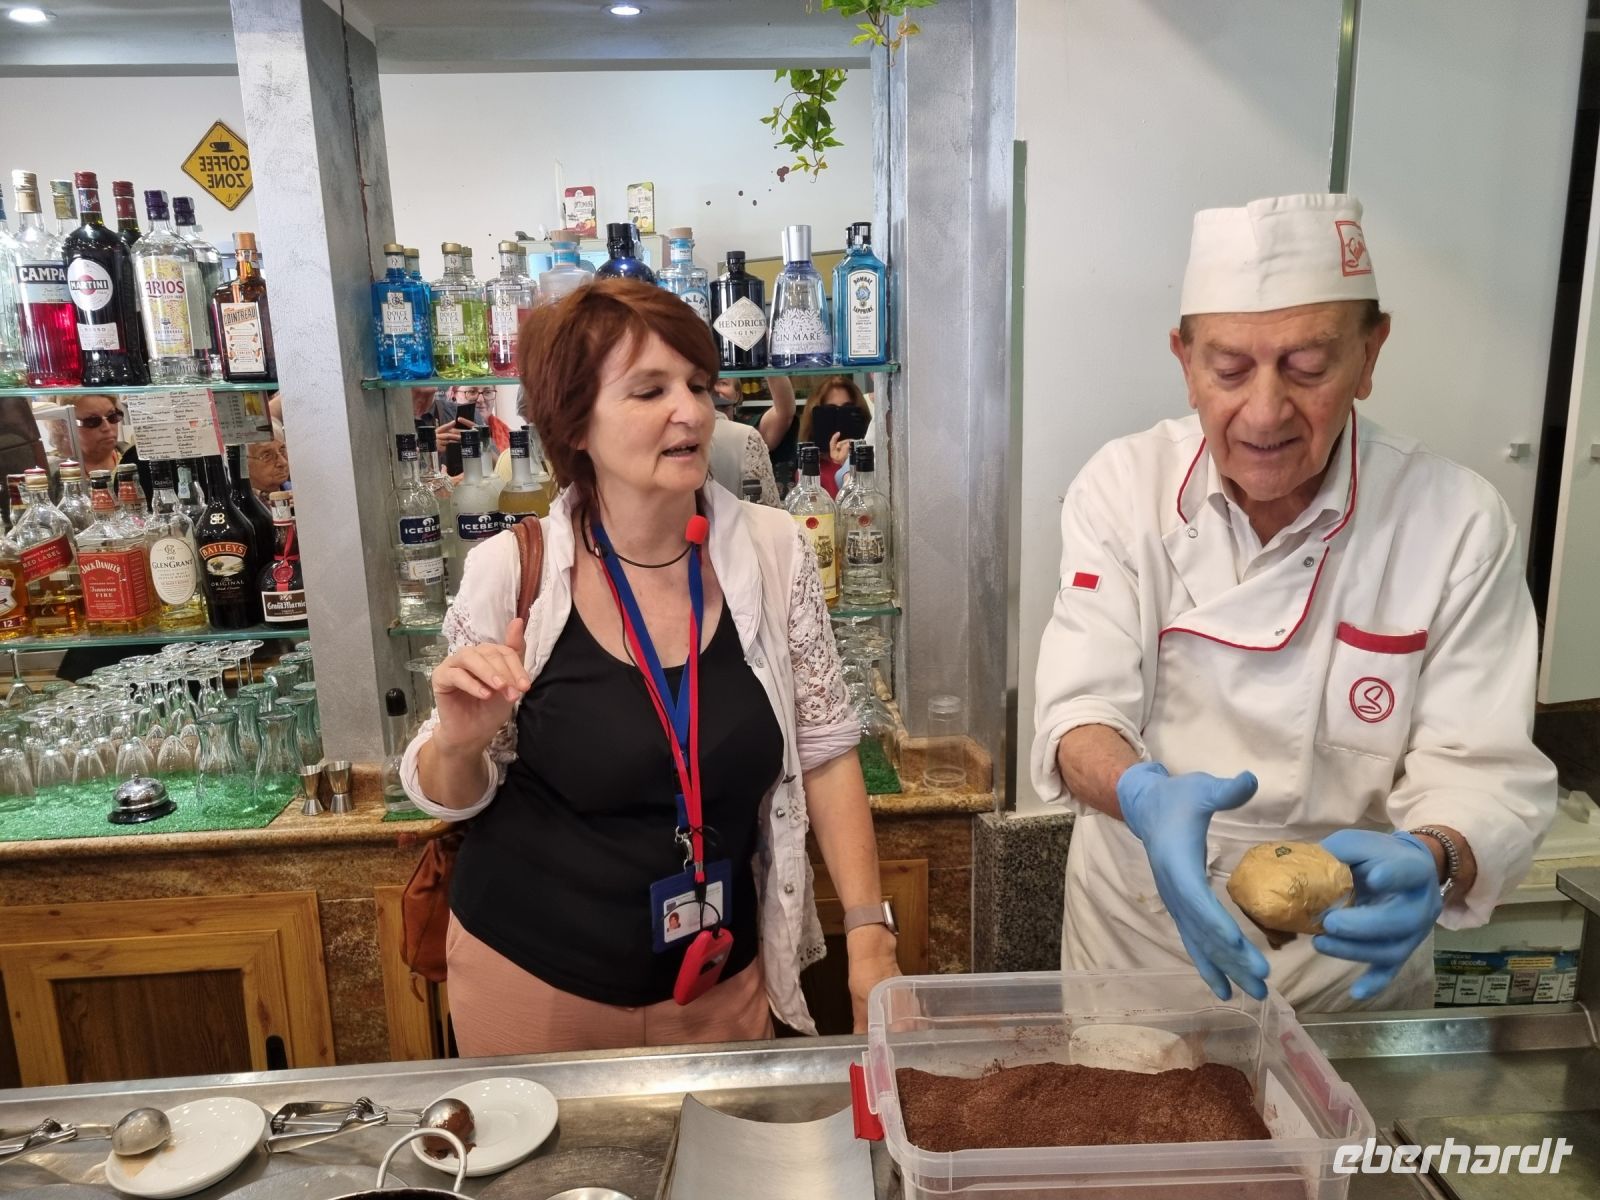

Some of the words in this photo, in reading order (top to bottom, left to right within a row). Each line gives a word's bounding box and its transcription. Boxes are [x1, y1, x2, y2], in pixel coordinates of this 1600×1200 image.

[19, 266, 66, 282] CAMPA
[70, 280, 108, 290] MARTINI
[853, 275, 873, 286] BOMBAY
[145, 279, 185, 295] ARIOS
[684, 294, 708, 309] ALFY
[852, 304, 874, 314] SAPPHIRE
[223, 305, 257, 326] COINTREAU
[793, 332, 821, 341] MARE
[461, 521, 500, 531] ICEBER
[203, 543, 244, 557] BAILEYS
[22, 559, 37, 569] RED
[37, 549, 61, 562] LABEL
[80, 561, 97, 575] JACK
[95, 559, 121, 575] DANIEL'S
[211, 580, 244, 588] ORIGINAL
[283, 601, 306, 610] Marnie
[3, 619, 14, 628] 12
